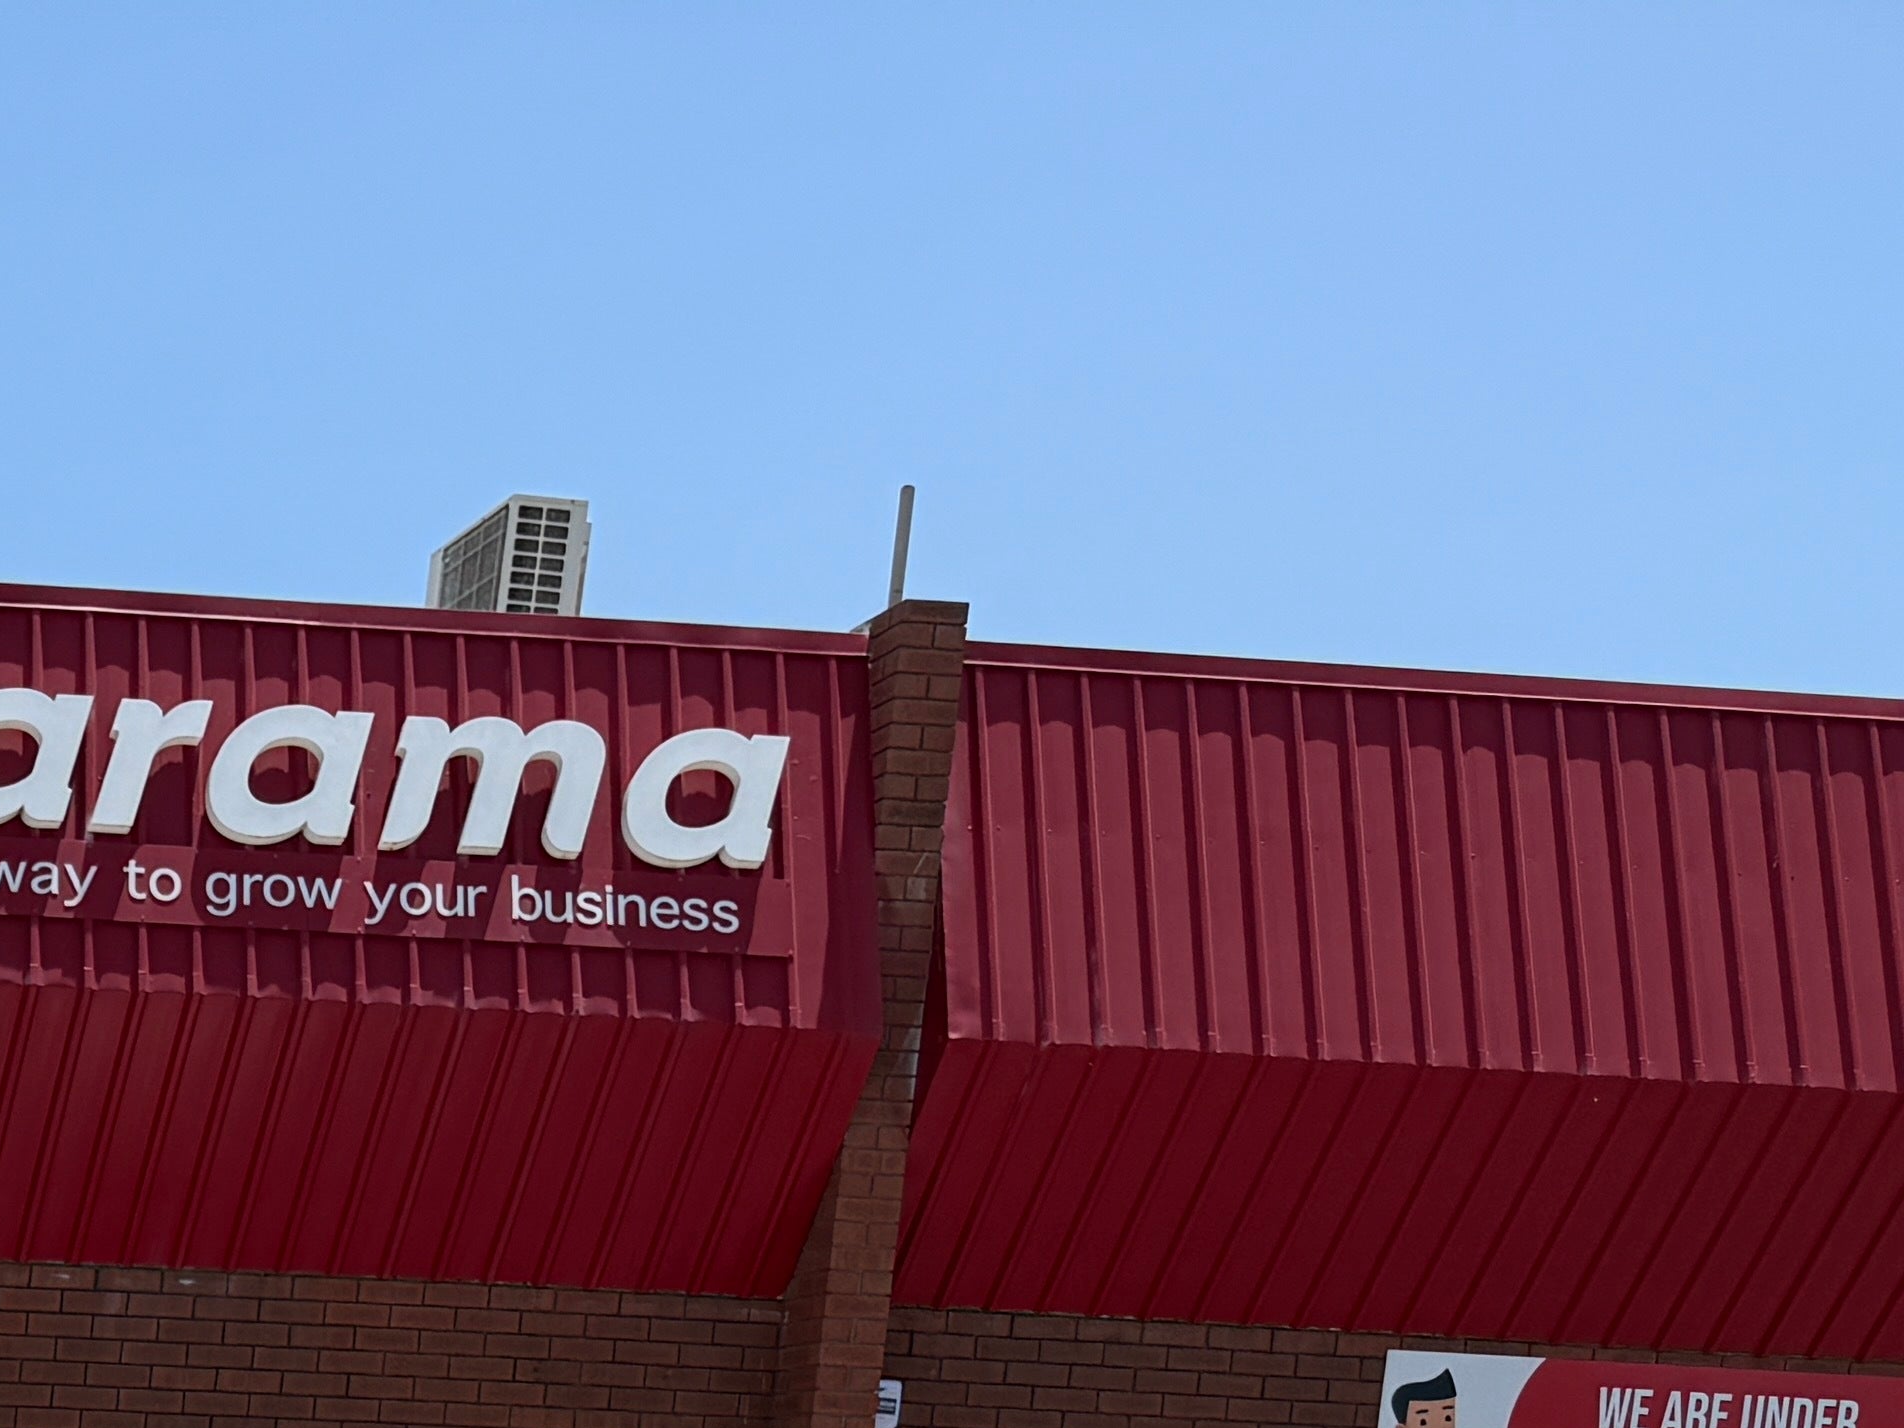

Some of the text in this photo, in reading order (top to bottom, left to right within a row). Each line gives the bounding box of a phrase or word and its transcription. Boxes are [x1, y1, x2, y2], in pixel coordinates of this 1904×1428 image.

[124, 860, 181, 901] to
[206, 872, 342, 916] grow
[364, 881, 487, 924] your
[509, 872, 742, 935] business
